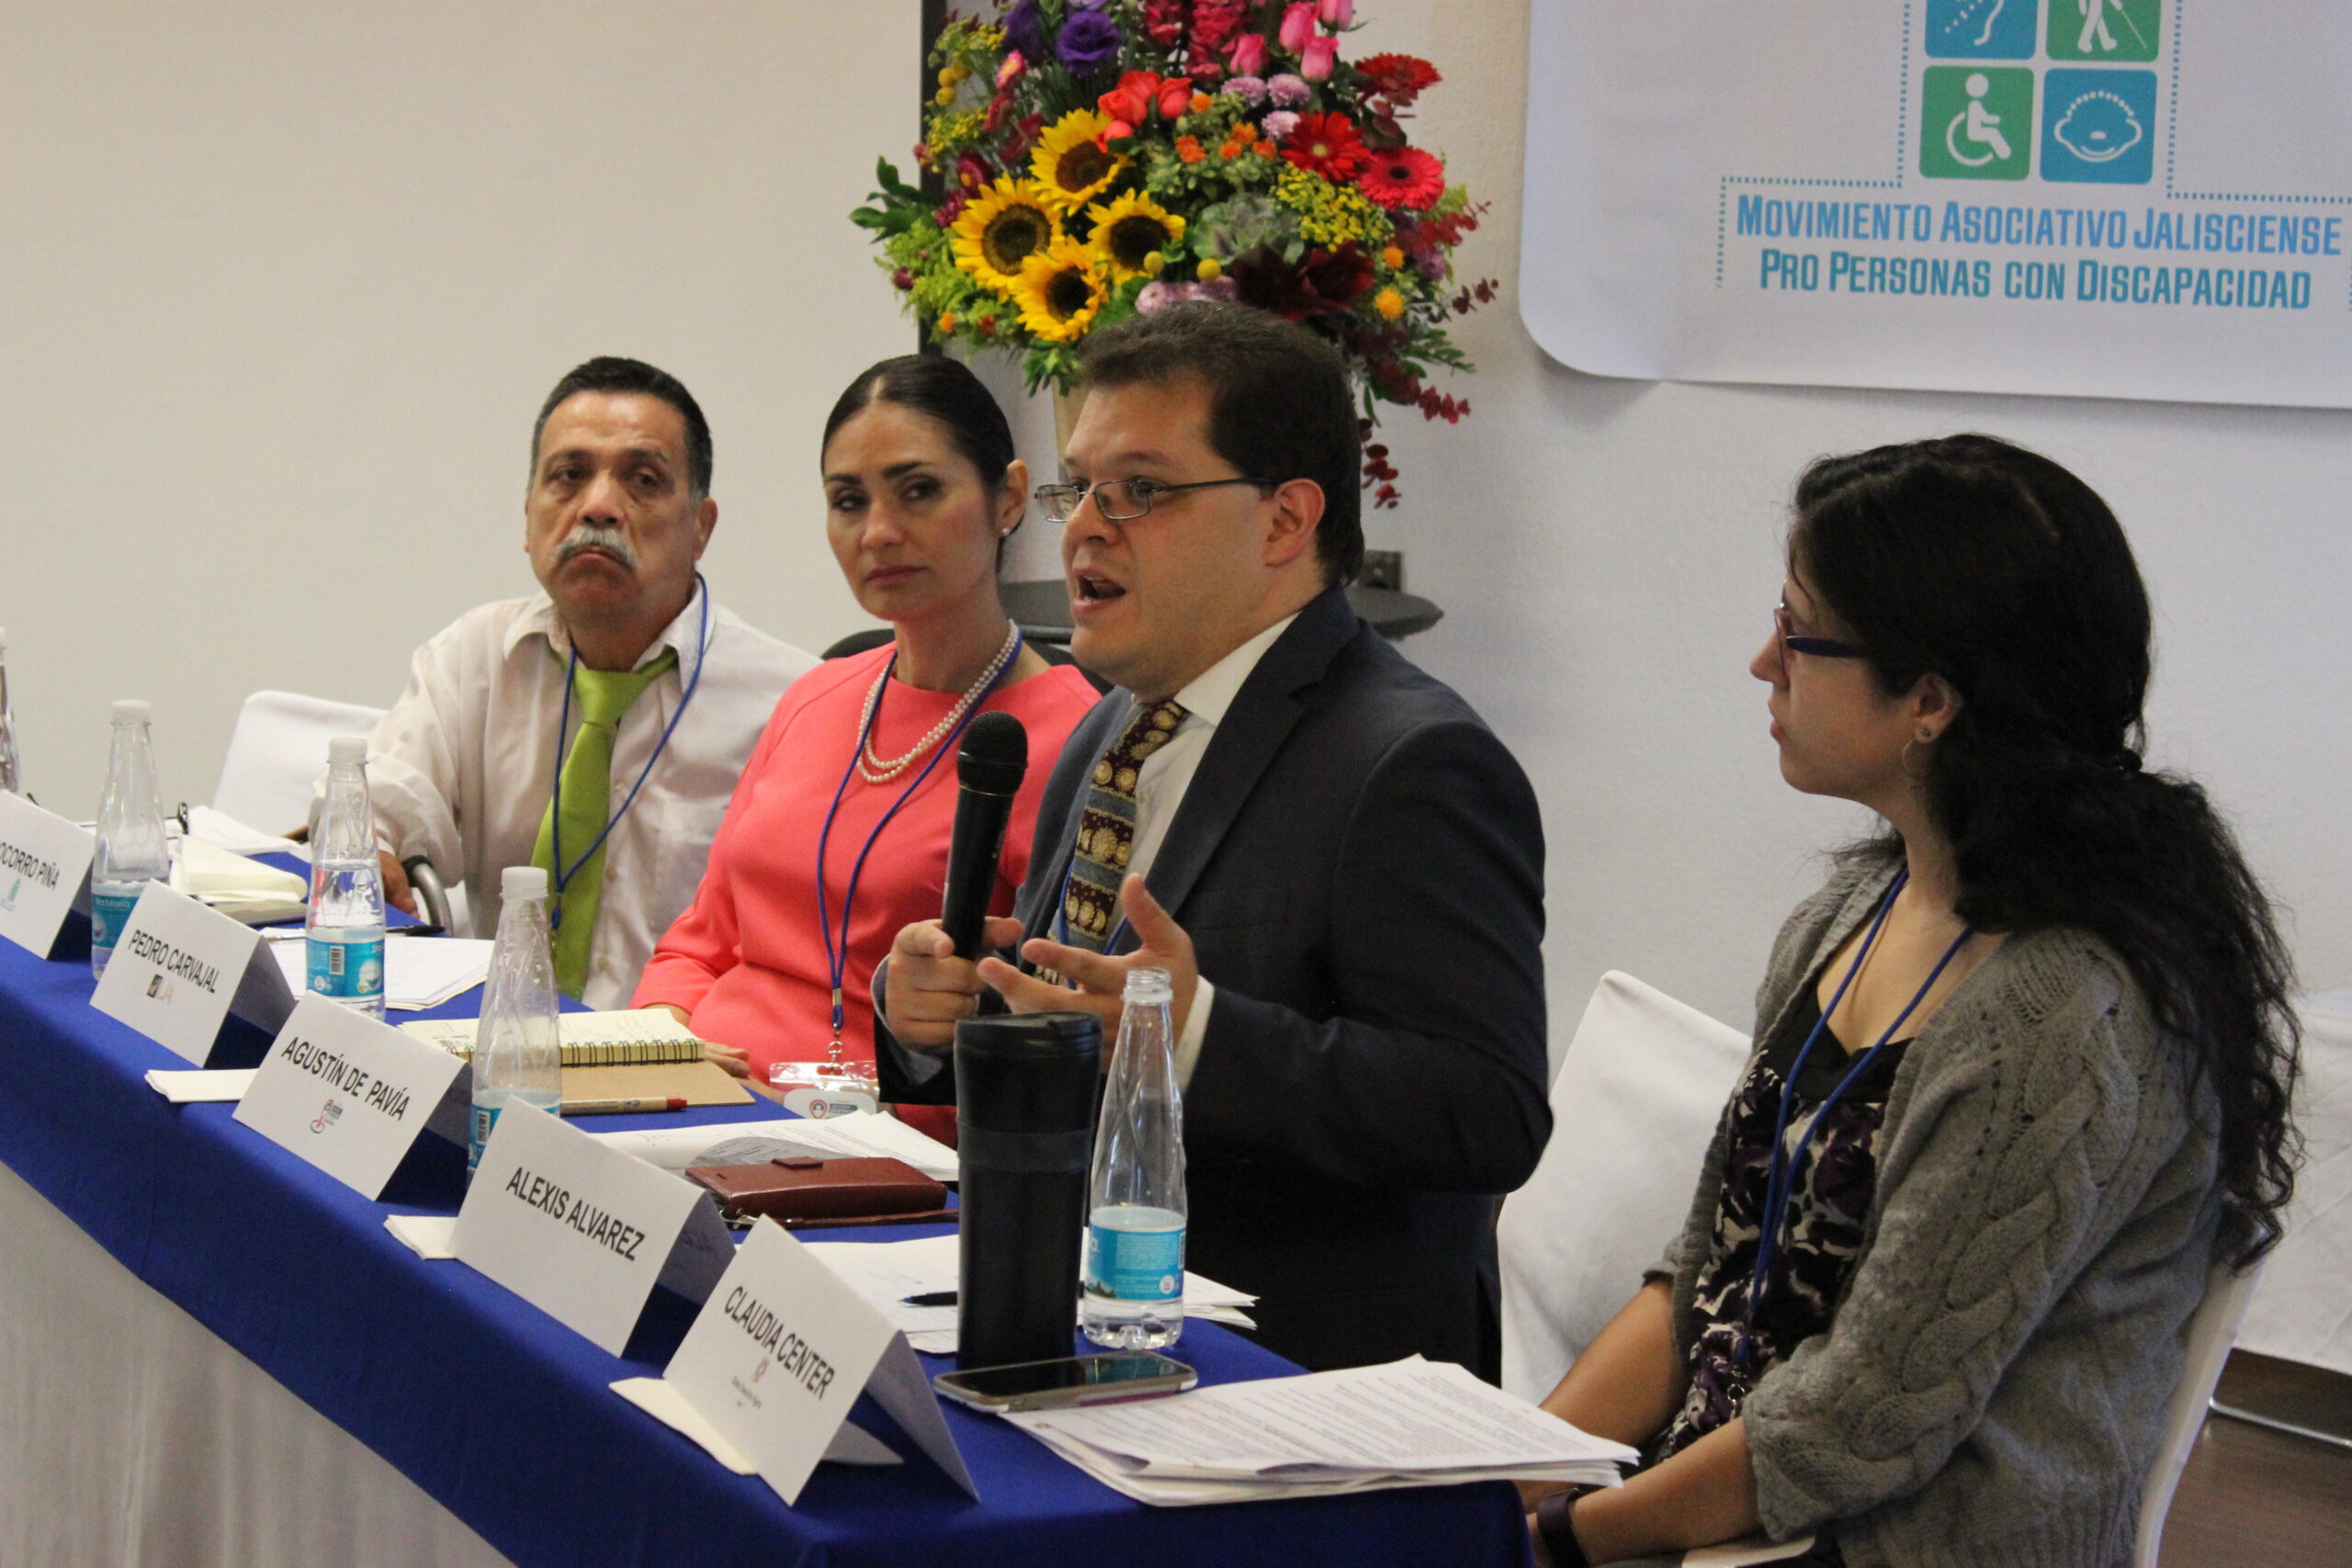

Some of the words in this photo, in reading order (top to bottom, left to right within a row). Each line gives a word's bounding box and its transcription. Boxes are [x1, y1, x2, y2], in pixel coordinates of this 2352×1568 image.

[1737, 195, 1931, 242] MOVIMIENTO
[1940, 200, 2127, 249] ASOCIATIVO
[2133, 208, 2342, 255] JALISCIENSE
[1760, 248, 1818, 291] PRO
[1829, 251, 1991, 298] PERSONAS
[2076, 259, 2311, 310] DISCAPACIDAD
[36, 862, 60, 891] PIÑA
[128, 929, 169, 966] PEDRO
[167, 949, 220, 994] CARVAJAL
[280, 1036, 349, 1087] AGUSTÍN
[343, 1067, 369, 1097] DE
[365, 1079, 410, 1121] PAVÍA
[505, 1166, 571, 1220] ALEXIS
[565, 1199, 646, 1262] ALVAREZ
[724, 1286, 784, 1354] CLAUDIA
[776, 1333, 835, 1401] CENTER
